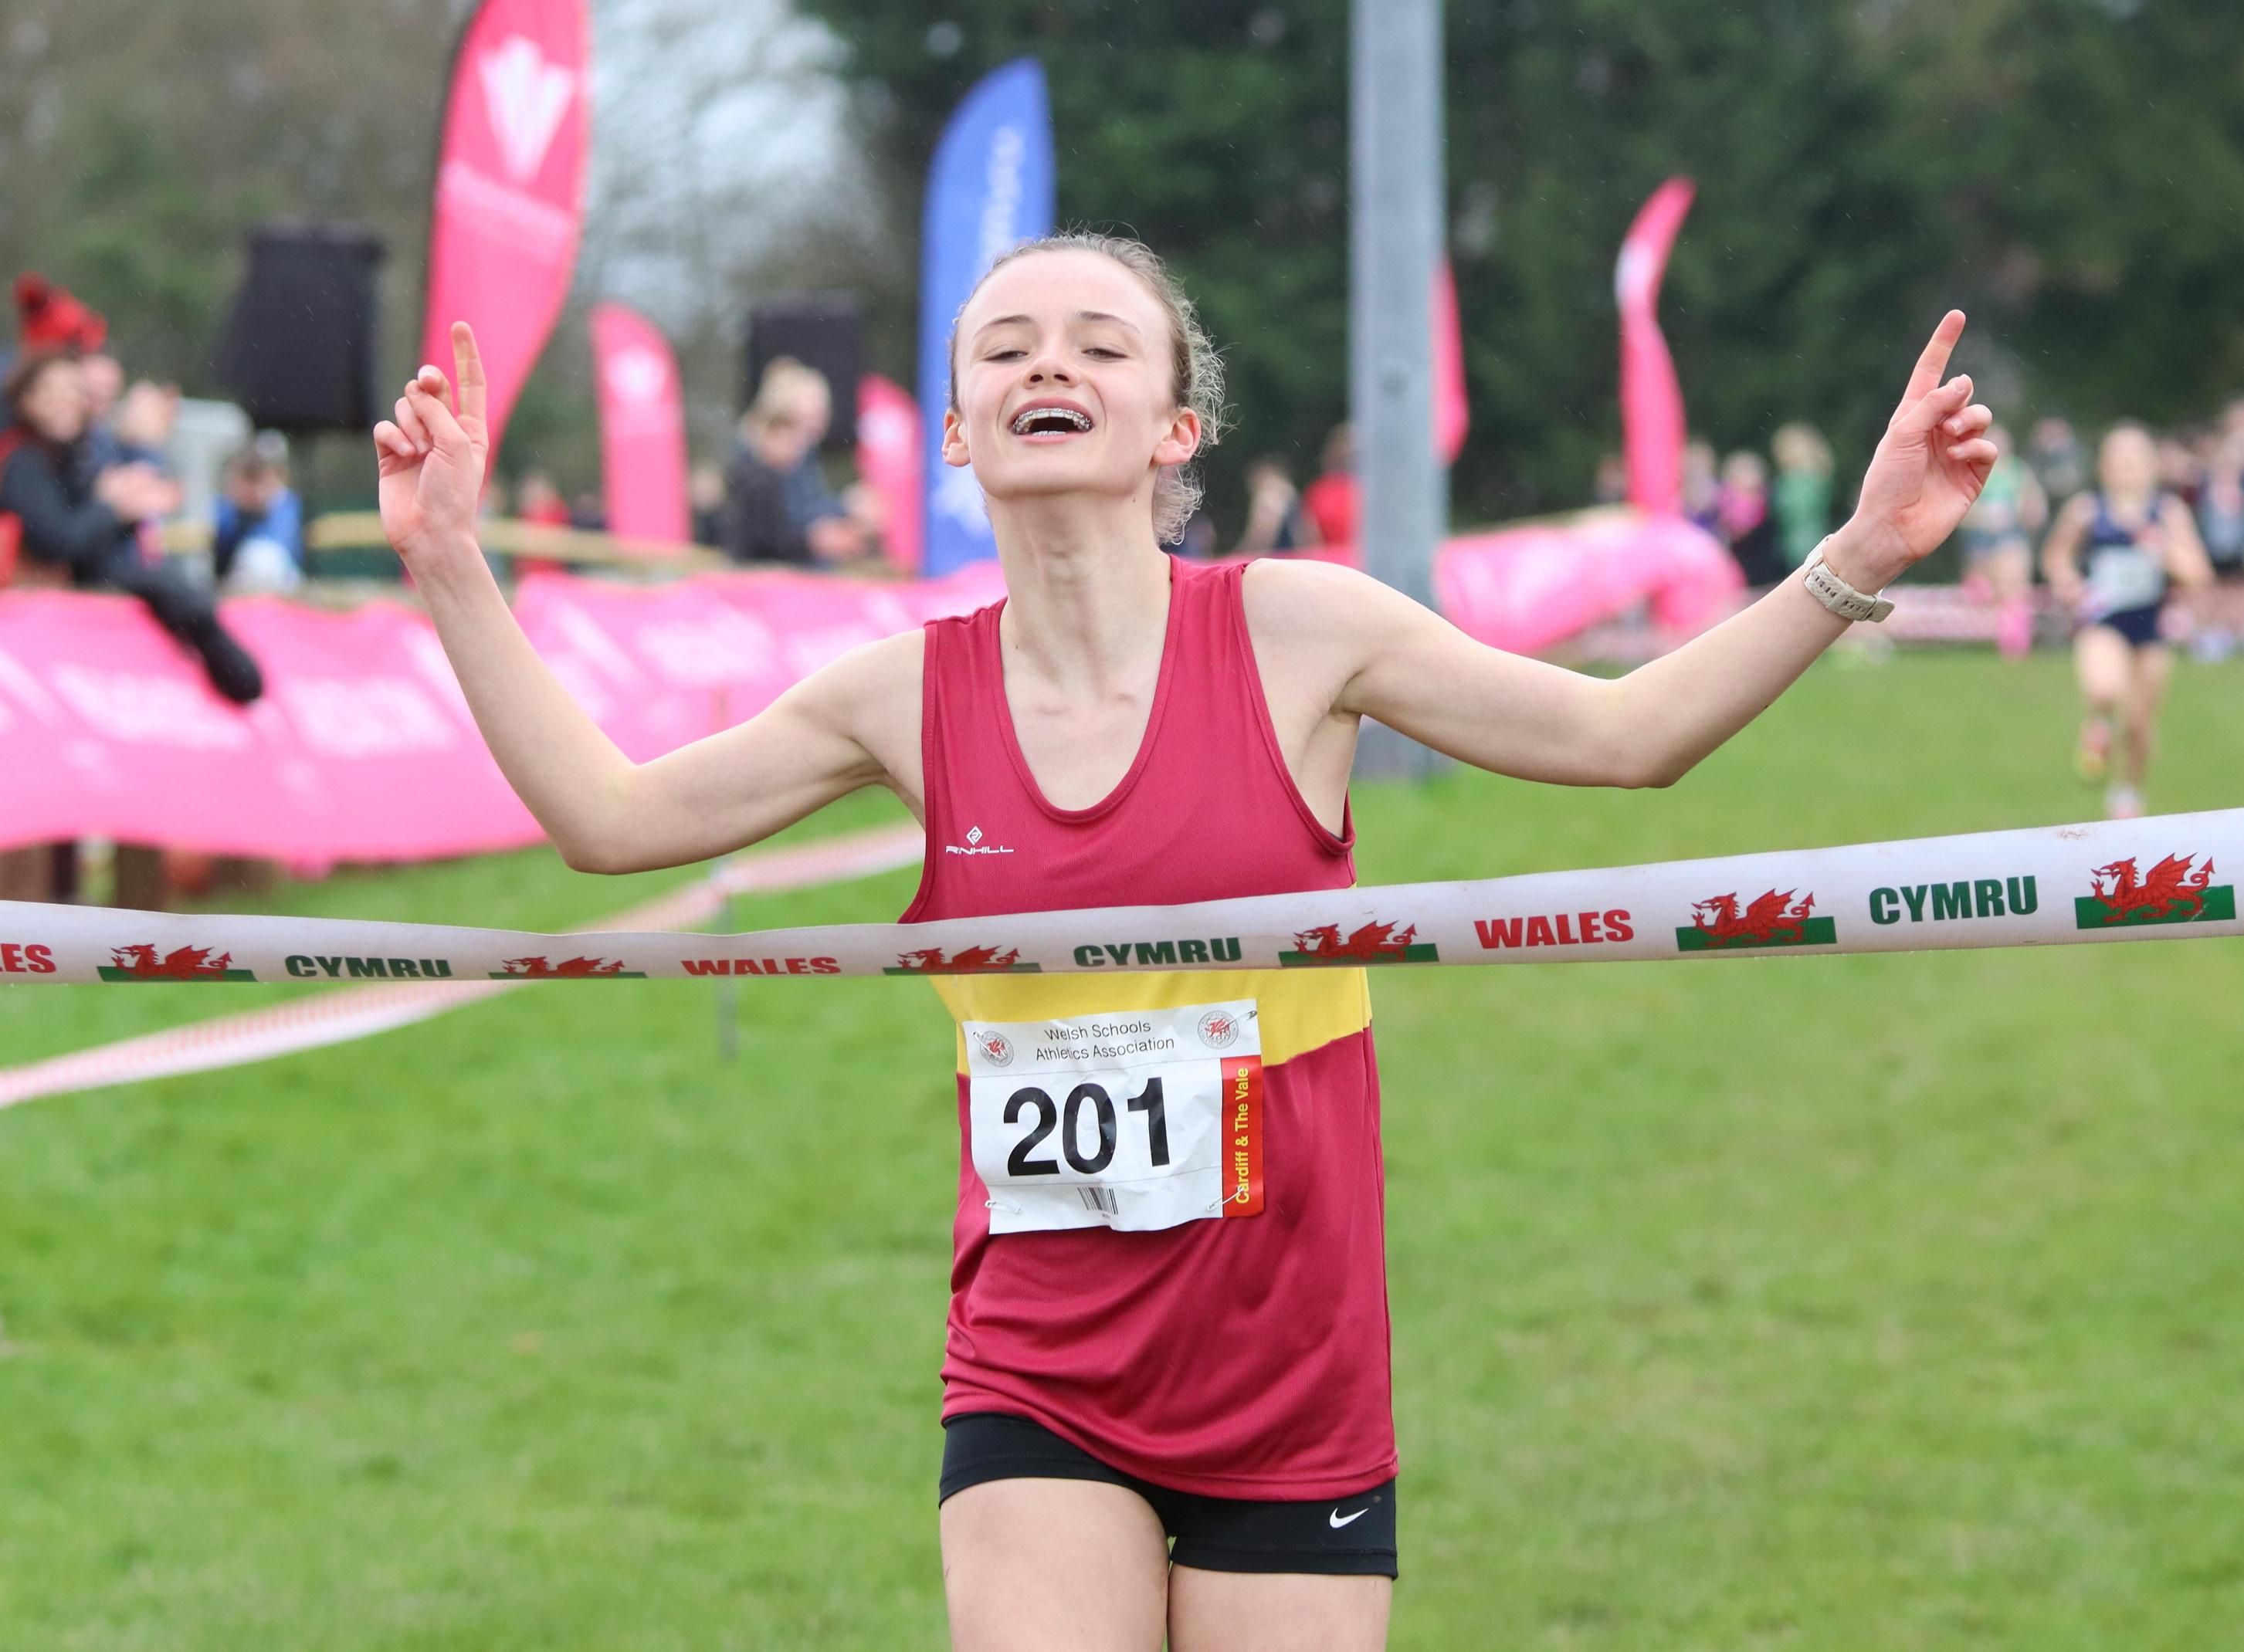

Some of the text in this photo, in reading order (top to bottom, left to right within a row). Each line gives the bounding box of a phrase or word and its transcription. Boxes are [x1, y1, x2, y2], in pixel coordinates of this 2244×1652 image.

[945, 845, 1015, 855] RNHILL
[284, 954, 453, 977] CYMRU
[681, 956, 842, 976] WALES
[1073, 936, 1242, 967] CYMRU
[1473, 909, 1634, 950] WALES
[1869, 875, 2039, 925] CYMRU
[1036, 1046, 1090, 1061] Athletics
[1093, 1037, 1175, 1058] Association
[1043, 1020, 1152, 1041] Welsh Schools
[1003, 1077, 1170, 1176] 201
[1235, 1067, 1250, 1203] Cardiff & The Vale
